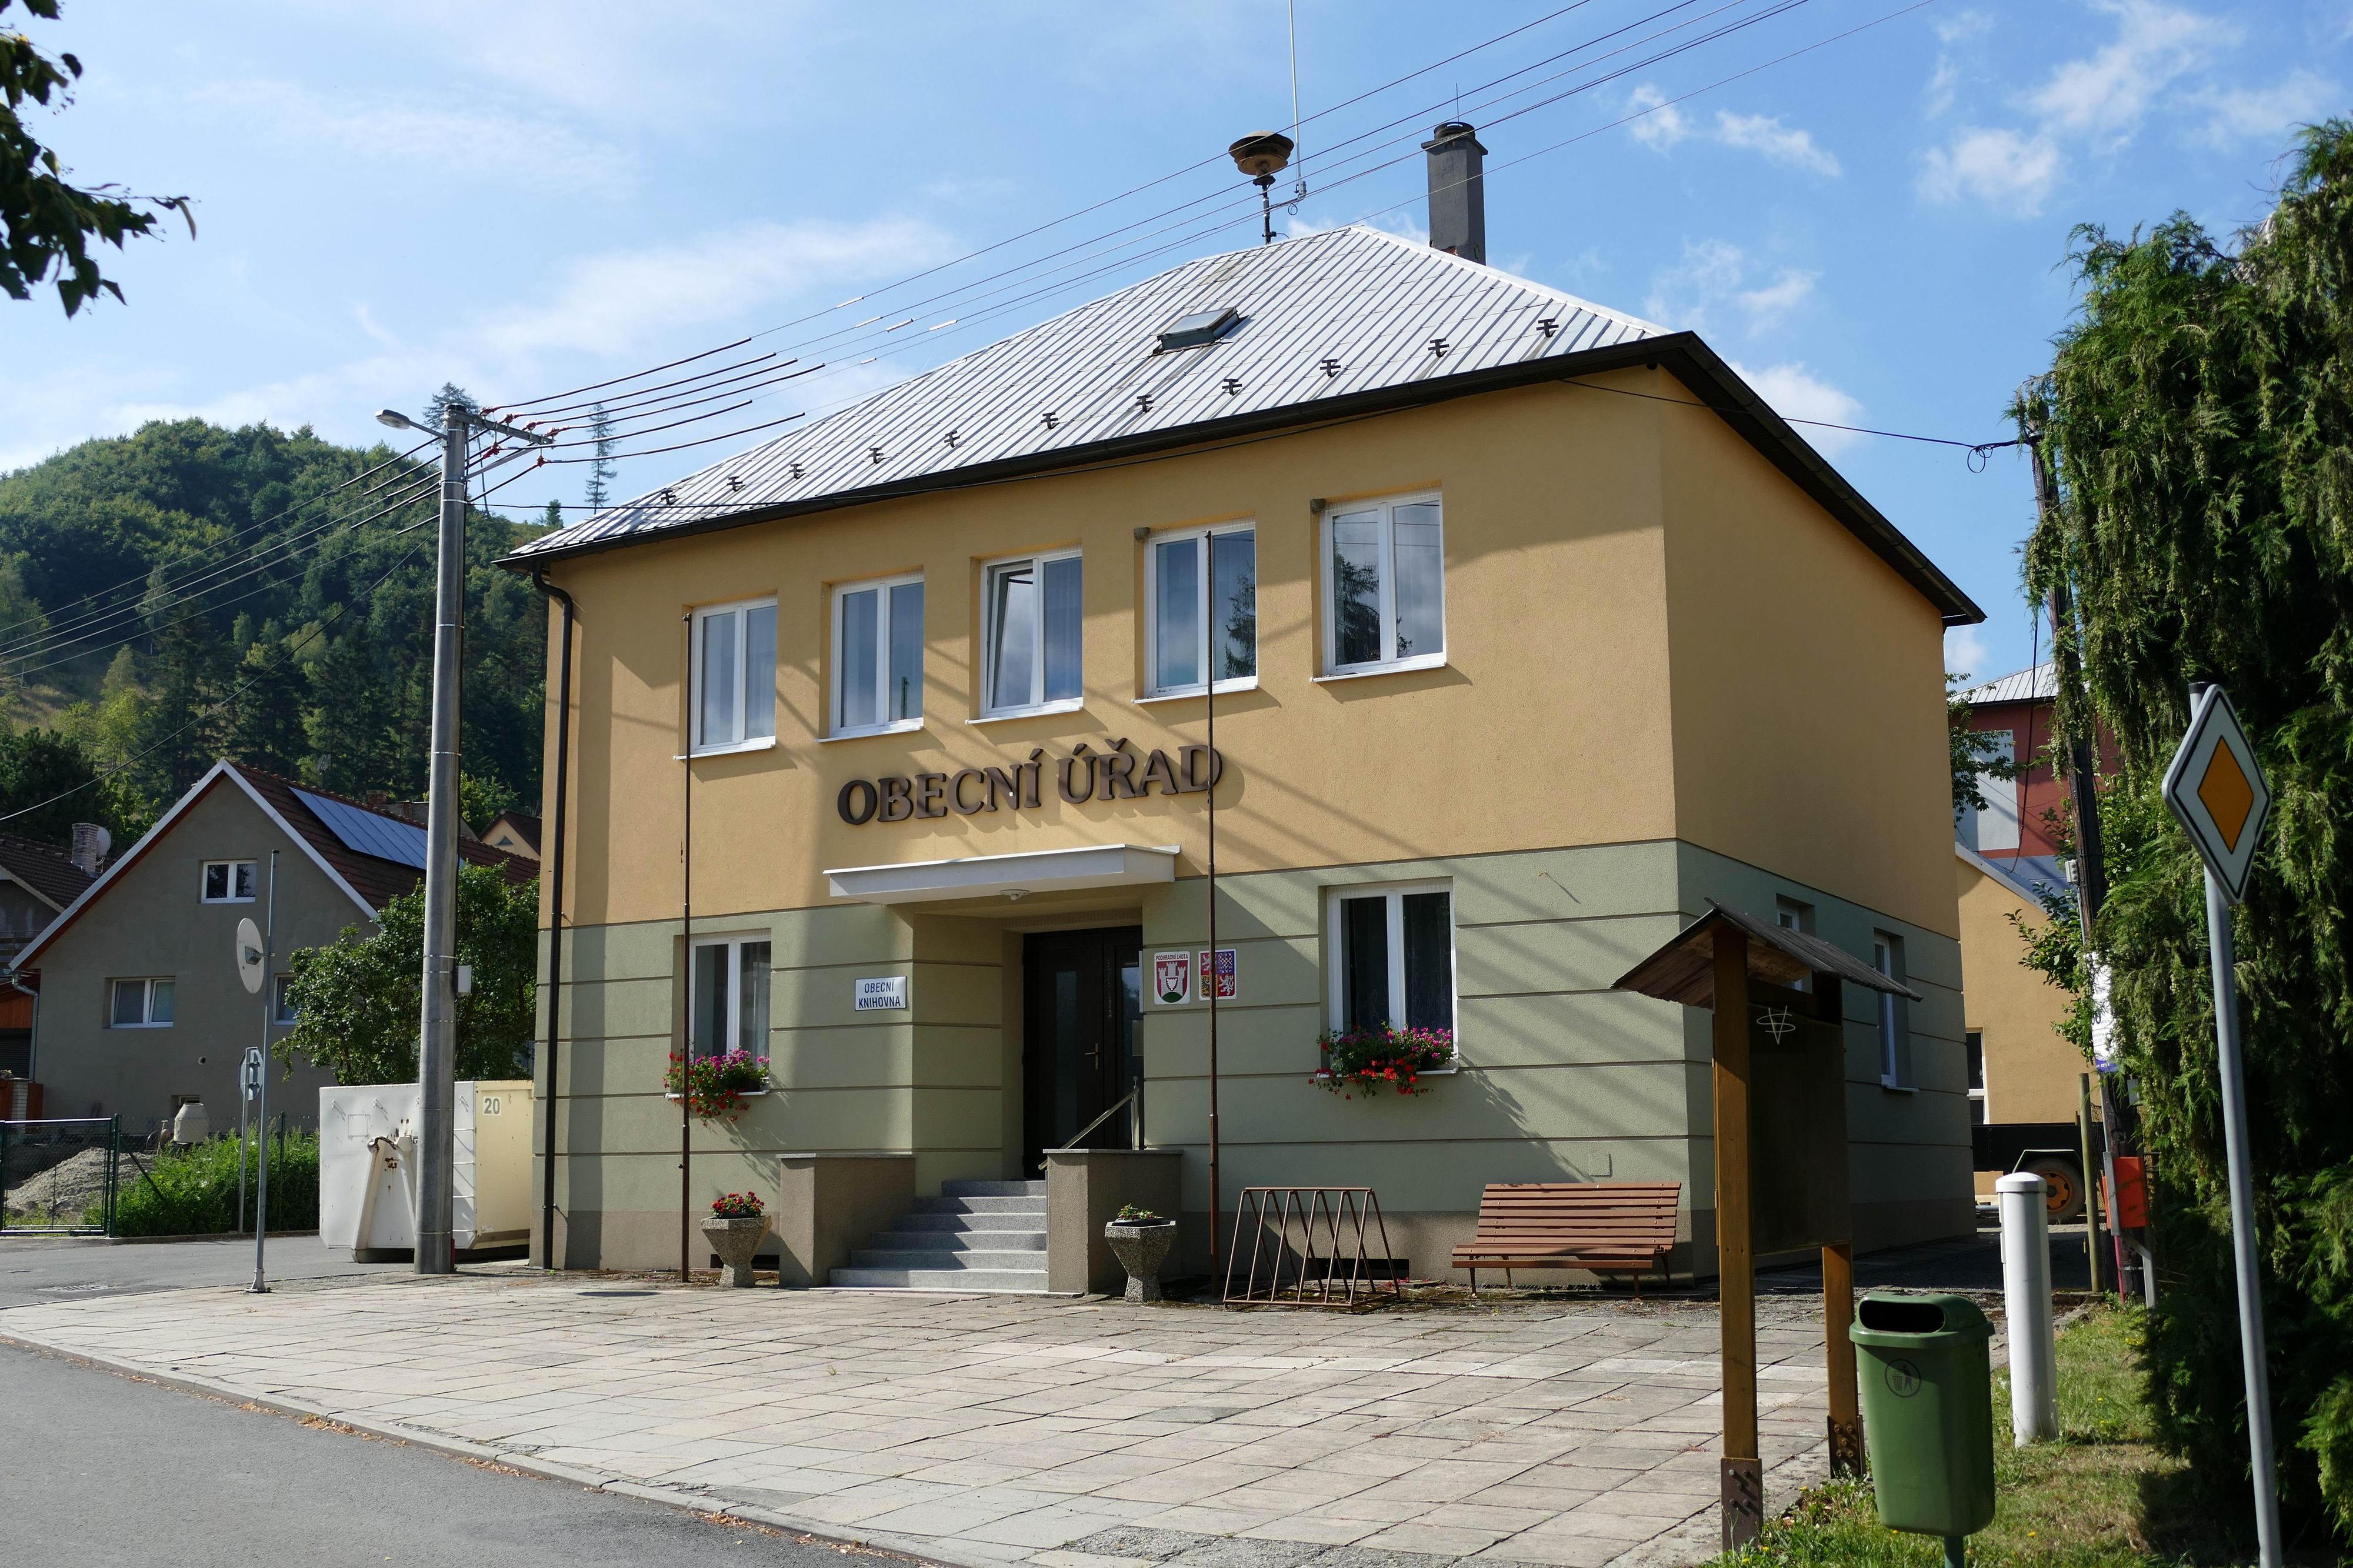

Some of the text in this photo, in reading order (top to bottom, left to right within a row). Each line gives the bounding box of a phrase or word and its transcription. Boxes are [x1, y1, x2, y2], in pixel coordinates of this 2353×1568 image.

[837, 738, 1223, 825] OBECNÍ ÚŘAD
[865, 979, 894, 993] OBECNÍ
[859, 996, 901, 1008] KNIHOVNA
[484, 1097, 500, 1115] 20
